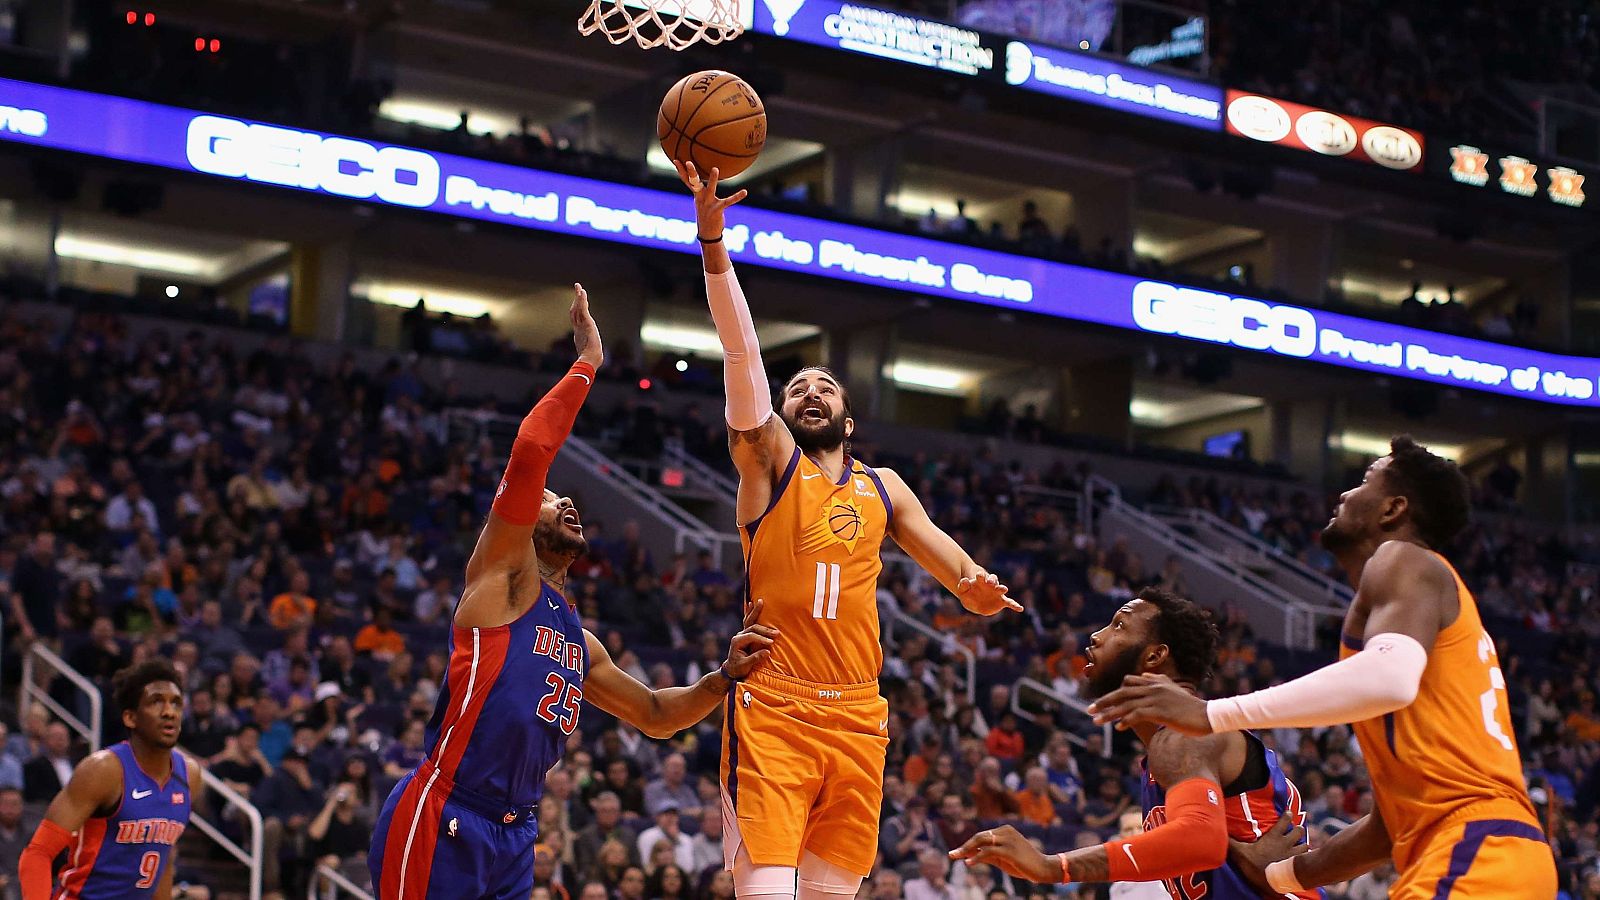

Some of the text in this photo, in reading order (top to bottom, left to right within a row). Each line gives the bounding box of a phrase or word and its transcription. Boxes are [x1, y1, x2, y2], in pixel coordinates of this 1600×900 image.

[824, 14, 993, 70] CONSTRUCTION
[186, 115, 440, 209] GEICO
[445, 175, 559, 222] Proud
[753, 231, 814, 265] the
[818, 239, 946, 288] Phoenix
[950, 263, 1034, 303] Suns
[1132, 281, 1316, 357] GEICO
[1319, 329, 1403, 368] Proud
[1406, 345, 1508, 386] Partner
[1510, 366, 1540, 392] of
[1541, 371, 1594, 399] the
[812, 561, 841, 620] 11
[536, 671, 584, 736] 25
[818, 689, 842, 701] PHX
[135, 851, 161, 889] 9
